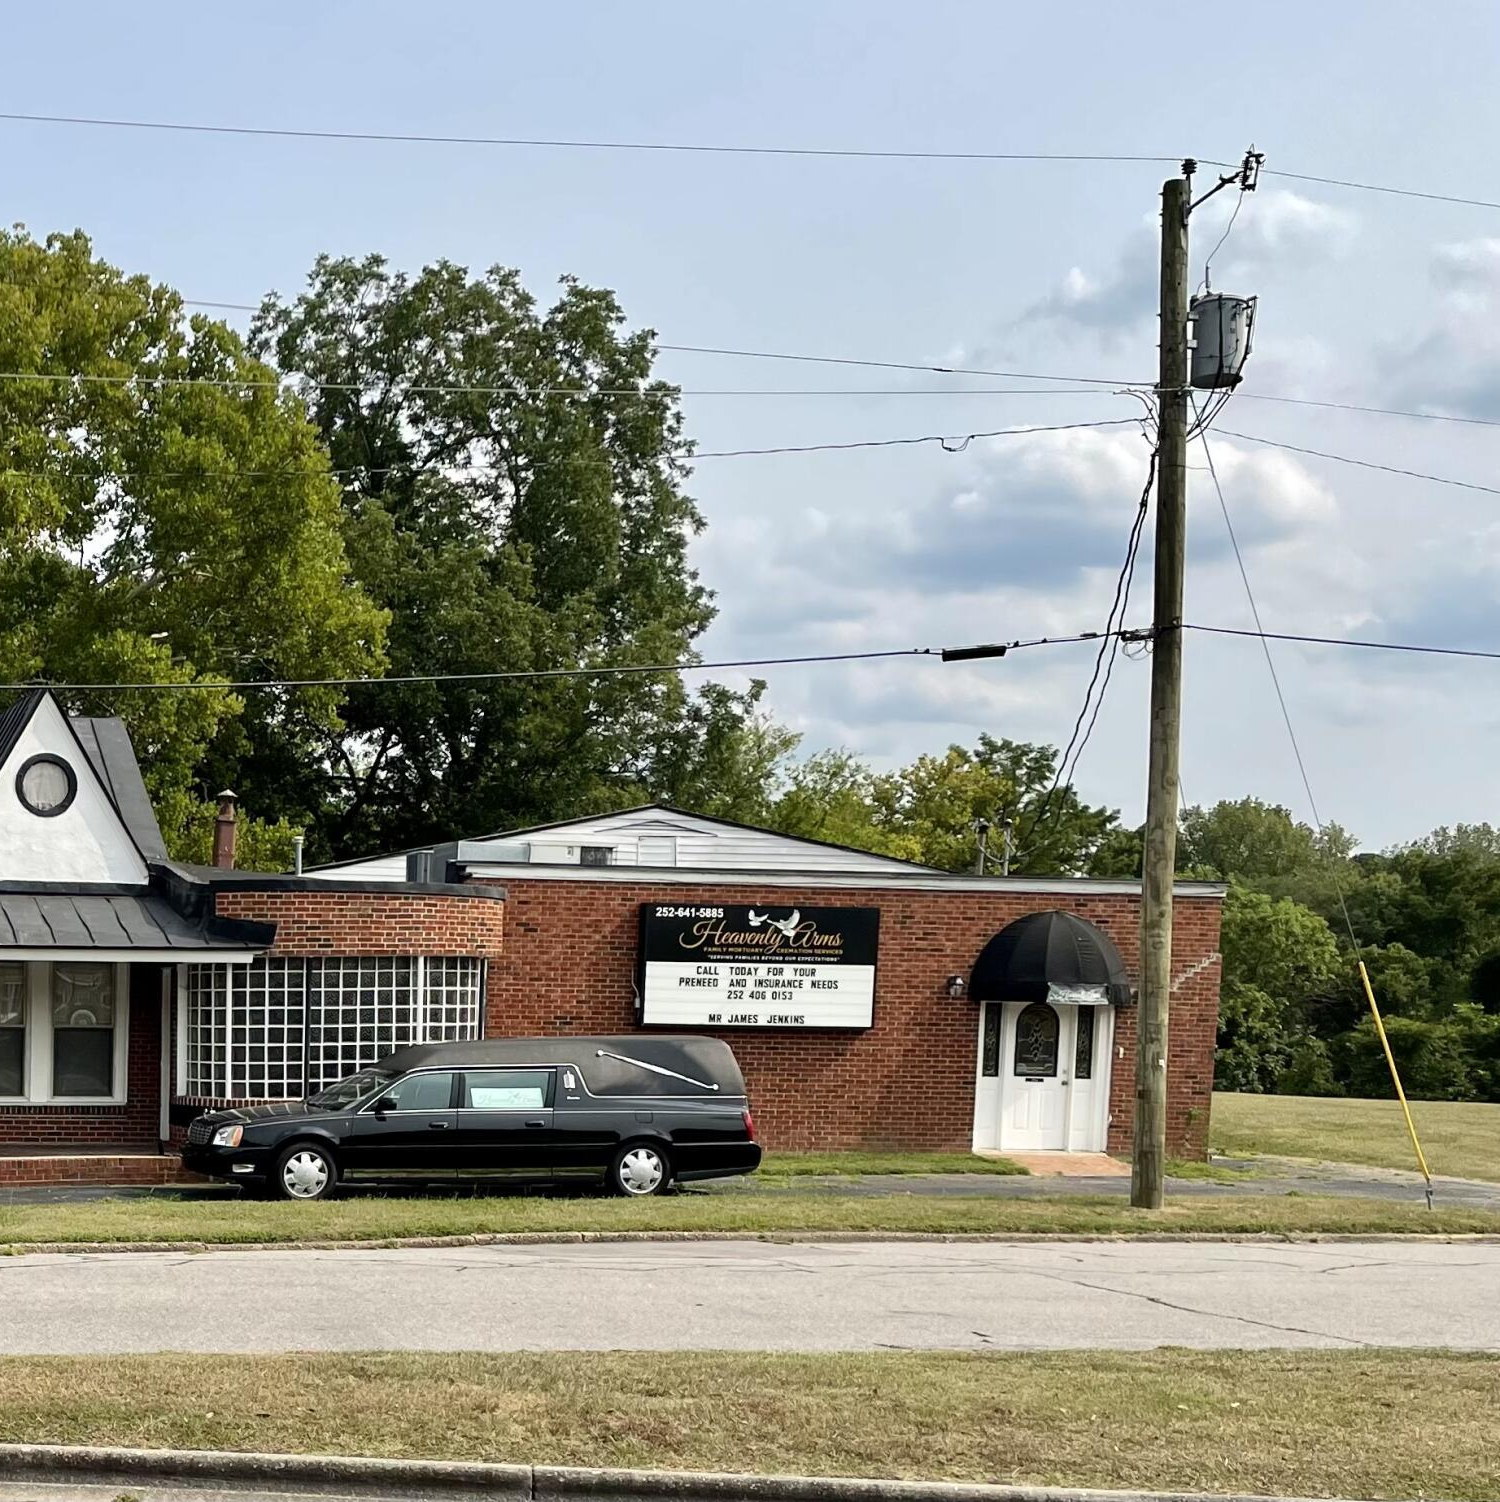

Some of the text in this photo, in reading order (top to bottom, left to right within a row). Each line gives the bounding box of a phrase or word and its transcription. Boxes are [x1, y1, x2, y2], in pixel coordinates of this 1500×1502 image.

[655, 906, 724, 918] 252-641-5885
[679, 919, 844, 955] Heavenly Arms
[696, 965, 817, 977] CALL TODAY FOR YOUR
[679, 977, 839, 989] PRENEED AND INSURANCE NEEDS
[727, 990, 793, 1000] 252 406 0153
[708, 1014, 805, 1024] MR JAMES JENKINS
